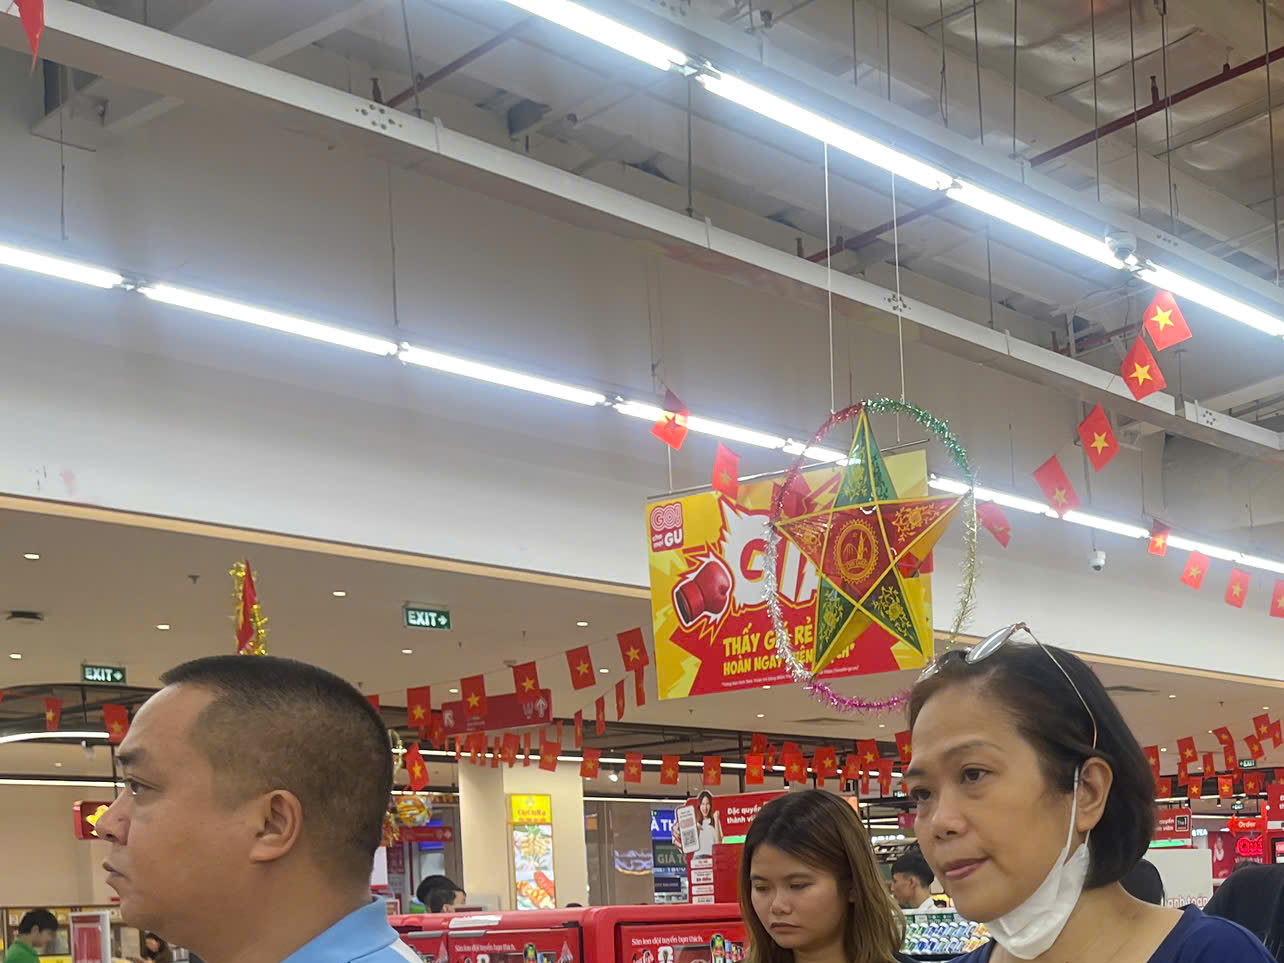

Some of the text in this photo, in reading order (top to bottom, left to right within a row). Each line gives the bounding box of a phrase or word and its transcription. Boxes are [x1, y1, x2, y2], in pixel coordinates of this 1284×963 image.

[664, 528, 683, 547] GU
[408, 610, 437, 627] EXIT
[722, 622, 761, 657] THẤY
[794, 616, 813, 646] RẺ
[85, 667, 113, 682] EXIT
[1238, 821, 1256, 829] Order
